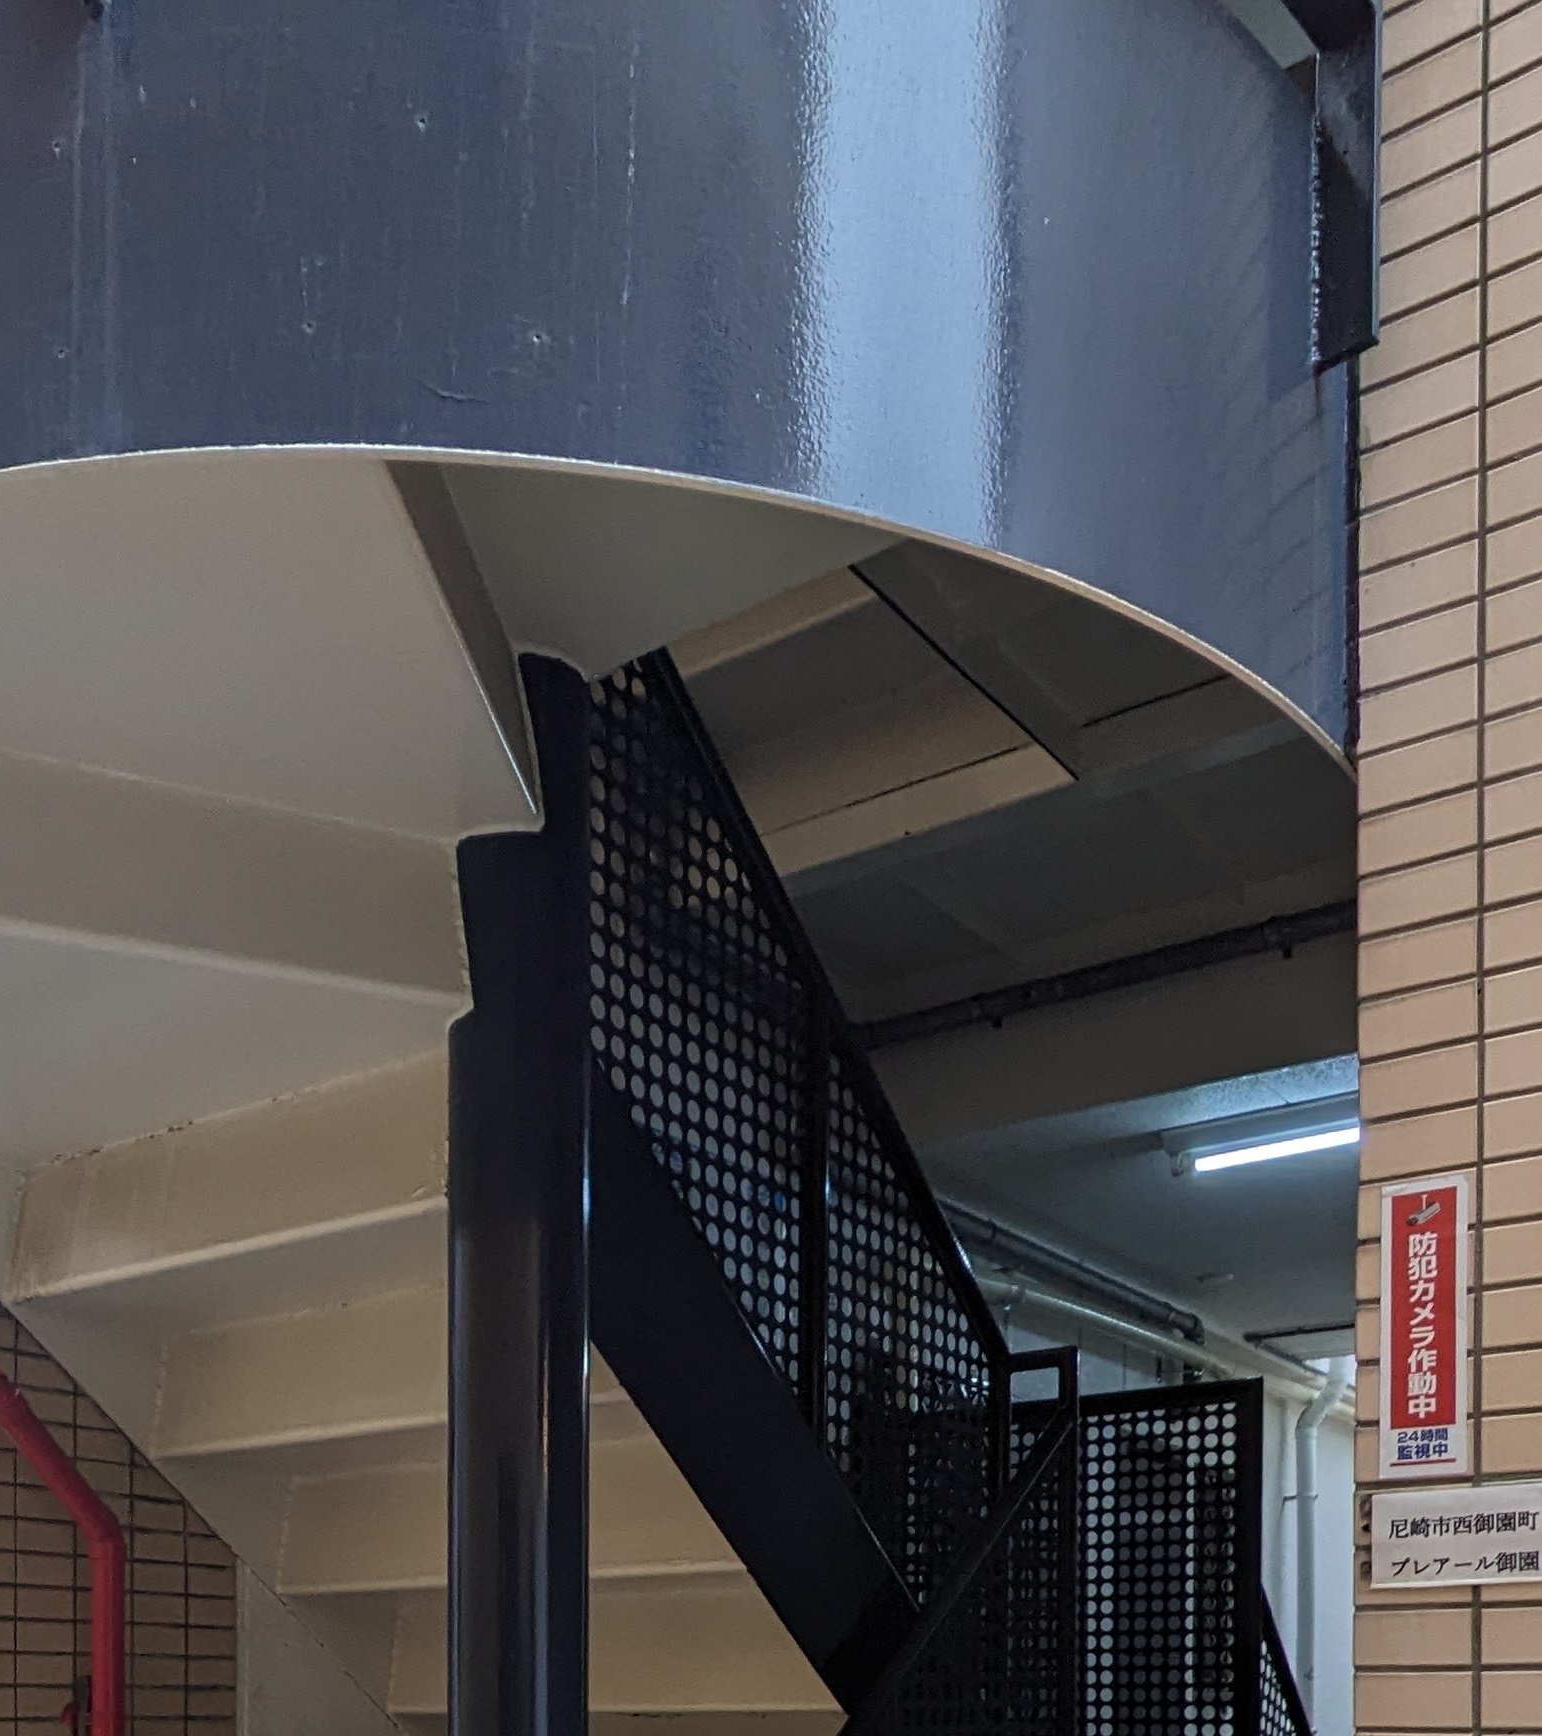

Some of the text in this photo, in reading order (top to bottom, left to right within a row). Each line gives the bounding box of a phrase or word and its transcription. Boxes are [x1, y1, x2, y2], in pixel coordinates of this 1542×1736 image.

[1407, 1232, 1438, 1419] 防犯カメラ作動中
[1397, 1428, 1448, 1443] 24時間
[1397, 1441, 1448, 1460] 監視中
